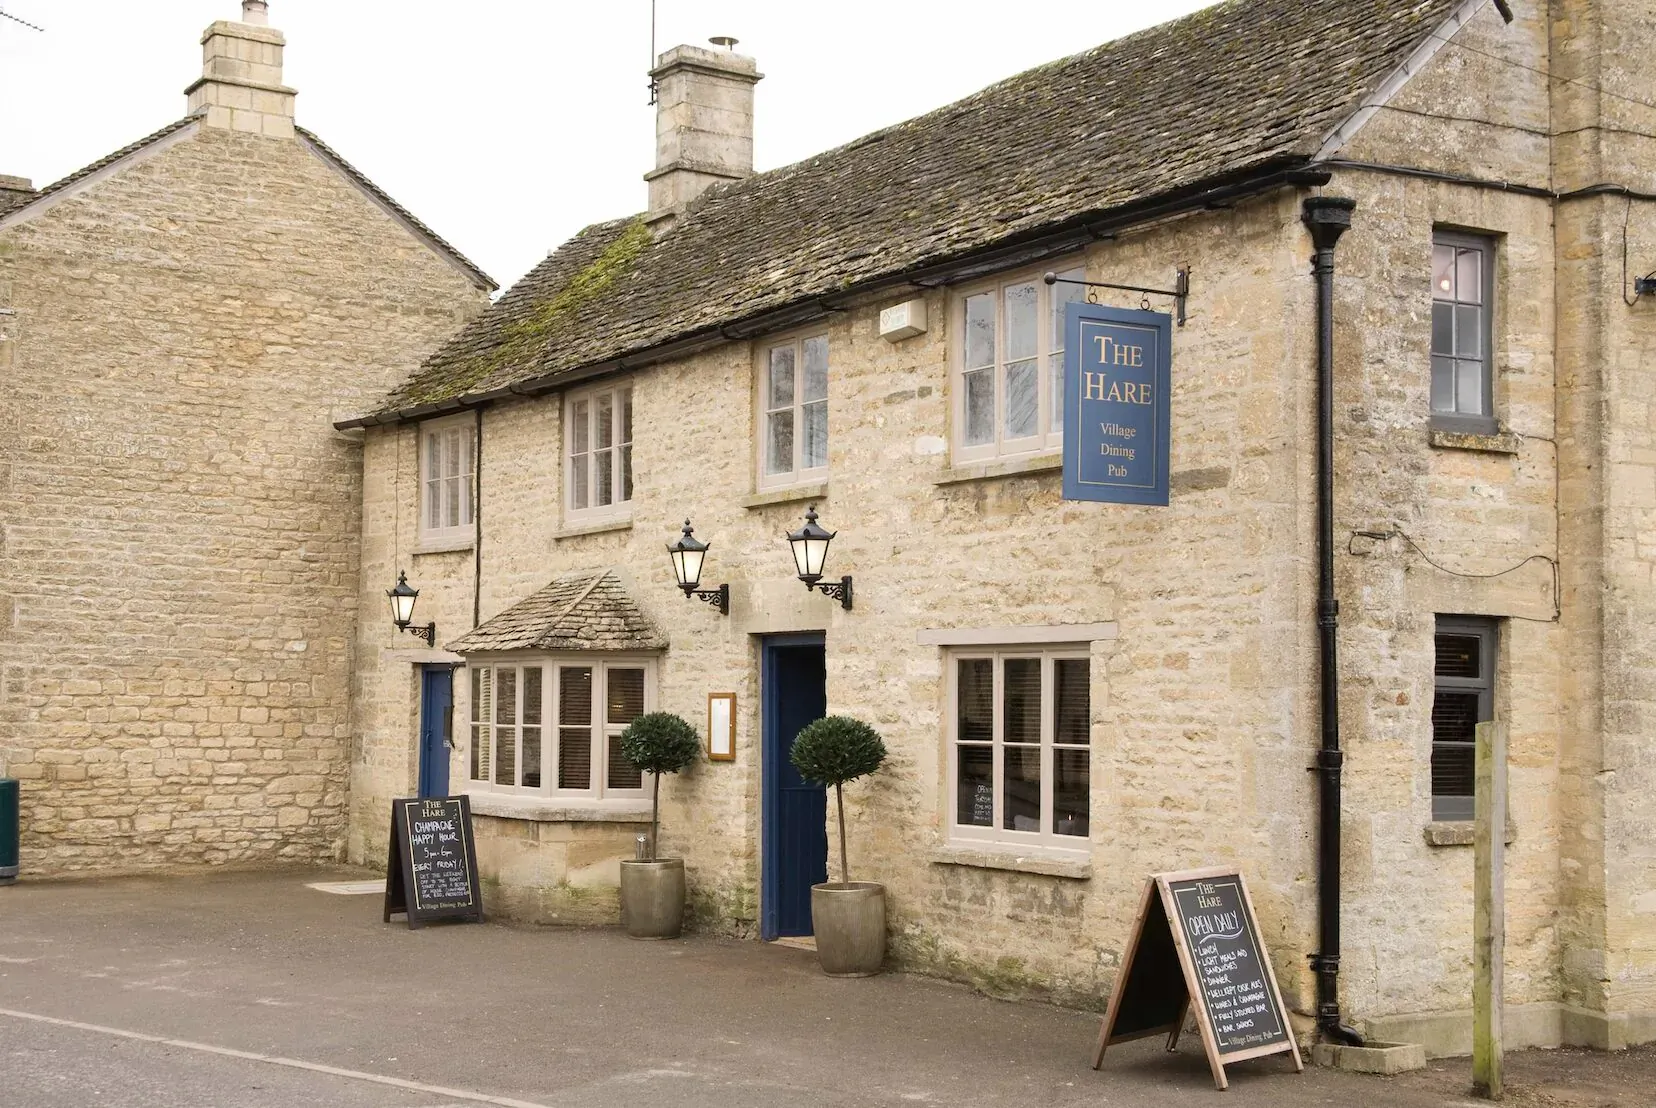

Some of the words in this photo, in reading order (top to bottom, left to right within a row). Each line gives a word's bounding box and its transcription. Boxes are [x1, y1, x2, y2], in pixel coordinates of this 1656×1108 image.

[1093, 335, 1144, 367] THE
[1083, 371, 1153, 405] HARE
[1099, 422, 1137, 440] Village
[1100, 442, 1136, 461] Dining
[1107, 463, 1128, 478] Pub
[424, 800, 441, 808] THE
[422, 809, 446, 817] HARE
[415, 820, 455, 833] CHAMPAGNE
[412, 834, 434, 845] HAPPY
[439, 832, 459, 842] HOUR
[1195, 882, 1216, 895] THE
[1197, 895, 1222, 909] HARE
[1189, 914, 1214, 936] OPEN
[1213, 909, 1240, 933] DAILY
[1206, 973, 1232, 986] DINNER
[1218, 1010, 1234, 1021] FULLY
[1255, 1002, 1269, 1013] BAR
[1222, 1024, 1236, 1033] BAR
[1228, 1036, 1247, 1046] Village
[1245, 1034, 1264, 1043] Dining
[1262, 1030, 1274, 1040] Pub
